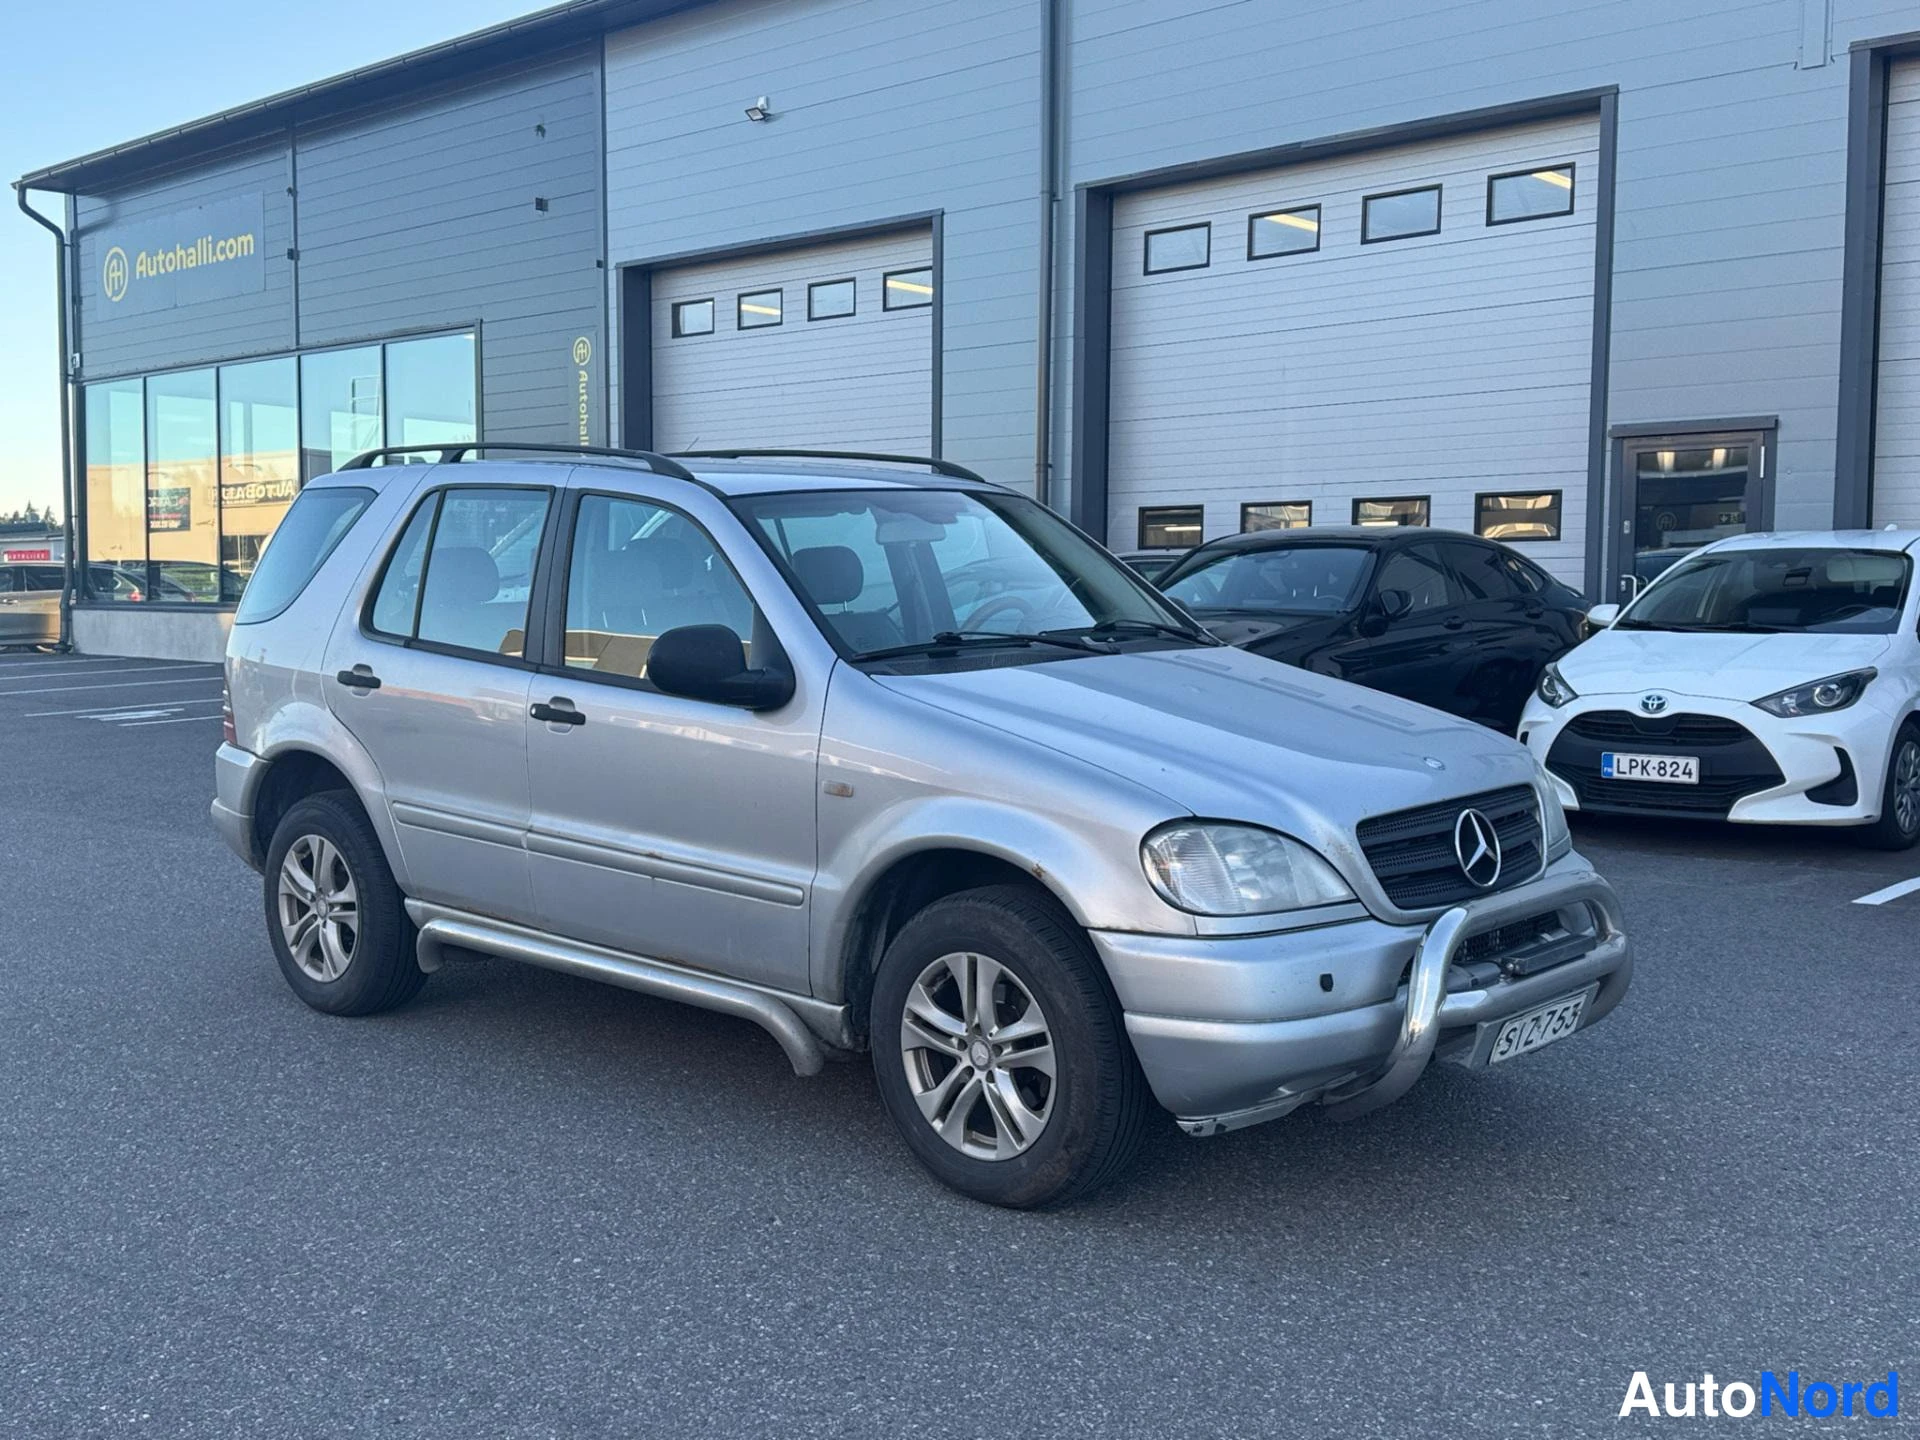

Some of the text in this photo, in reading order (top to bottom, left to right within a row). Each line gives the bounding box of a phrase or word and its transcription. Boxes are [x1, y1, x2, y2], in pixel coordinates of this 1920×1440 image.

[135, 233, 254, 280] Autohalli.com
[578, 370, 590, 446] Autohall
[1616, 757, 1693, 779] LPK-824
[1497, 1001, 1582, 1056] SIZ-753
